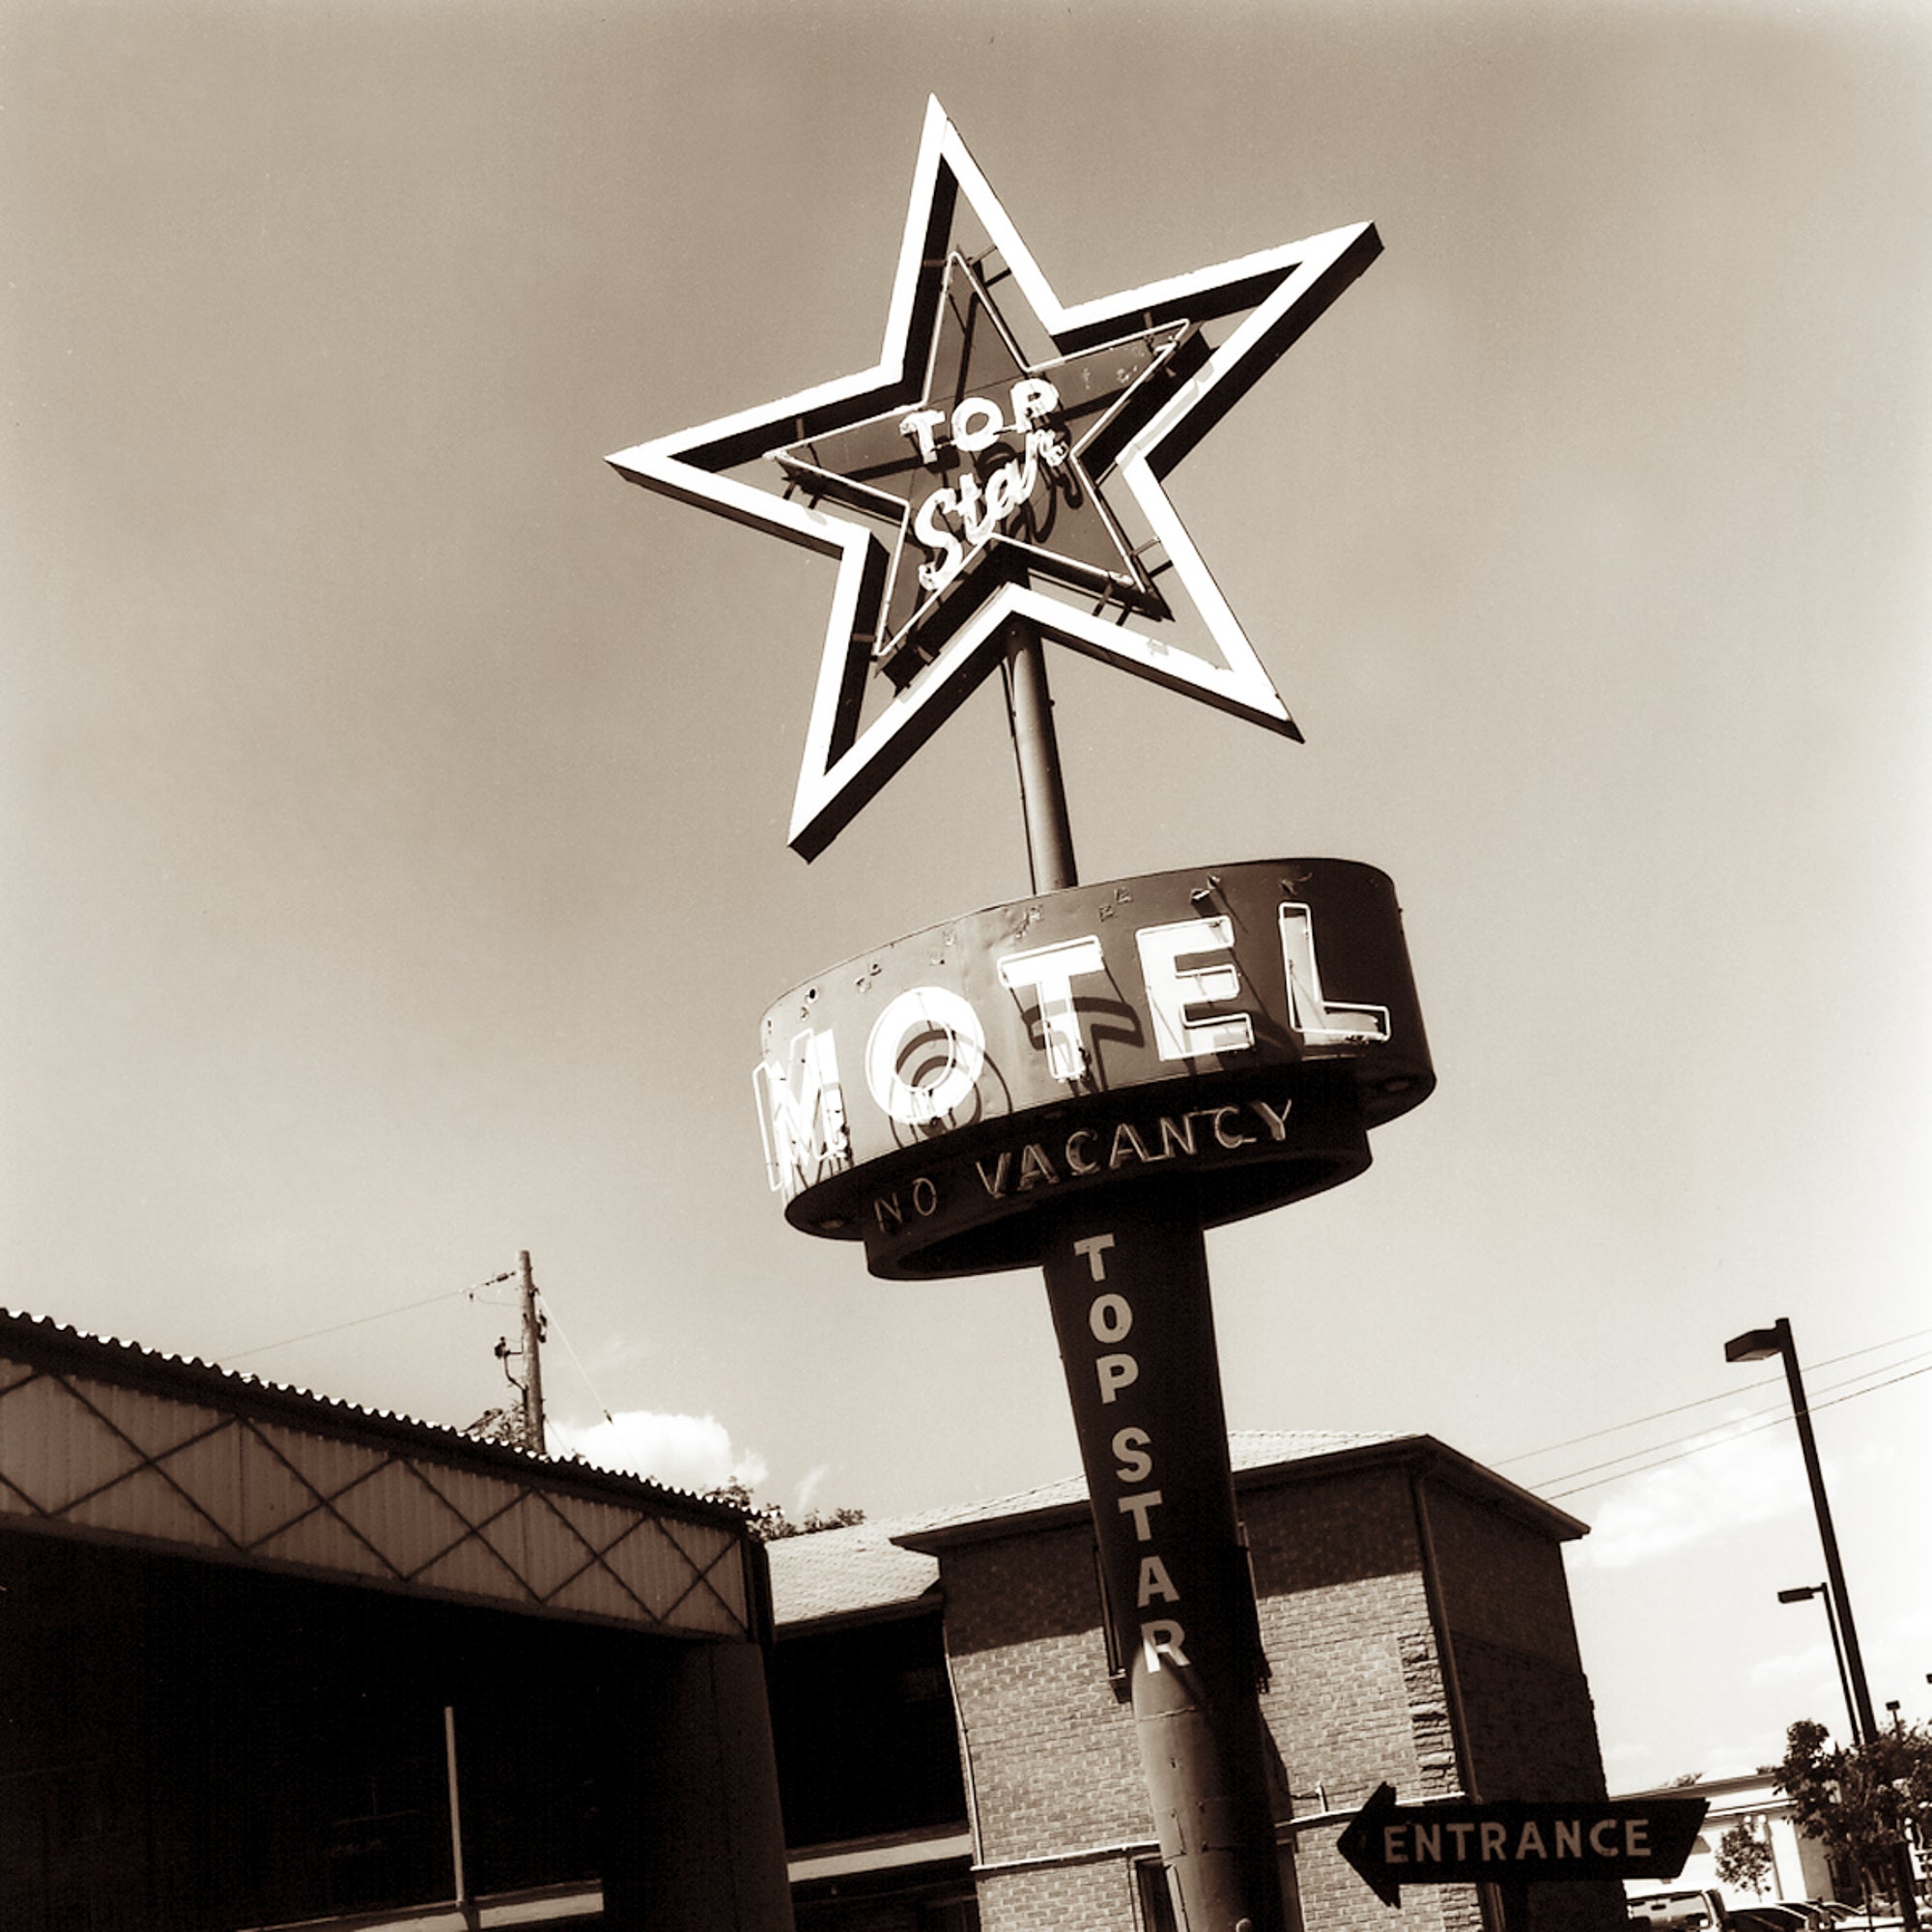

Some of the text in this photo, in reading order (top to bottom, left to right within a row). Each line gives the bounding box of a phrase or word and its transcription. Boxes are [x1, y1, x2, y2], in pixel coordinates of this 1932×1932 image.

[899, 379, 1059, 464] TOP
[915, 430, 1067, 590] Star
[753, 902, 1391, 1194] MOTEL
[873, 1099, 1293, 1233] NO VACANCY
[1074, 1234, 1190, 1673] TOP STAR
[1383, 1819, 1652, 1864] ENTRANCE
